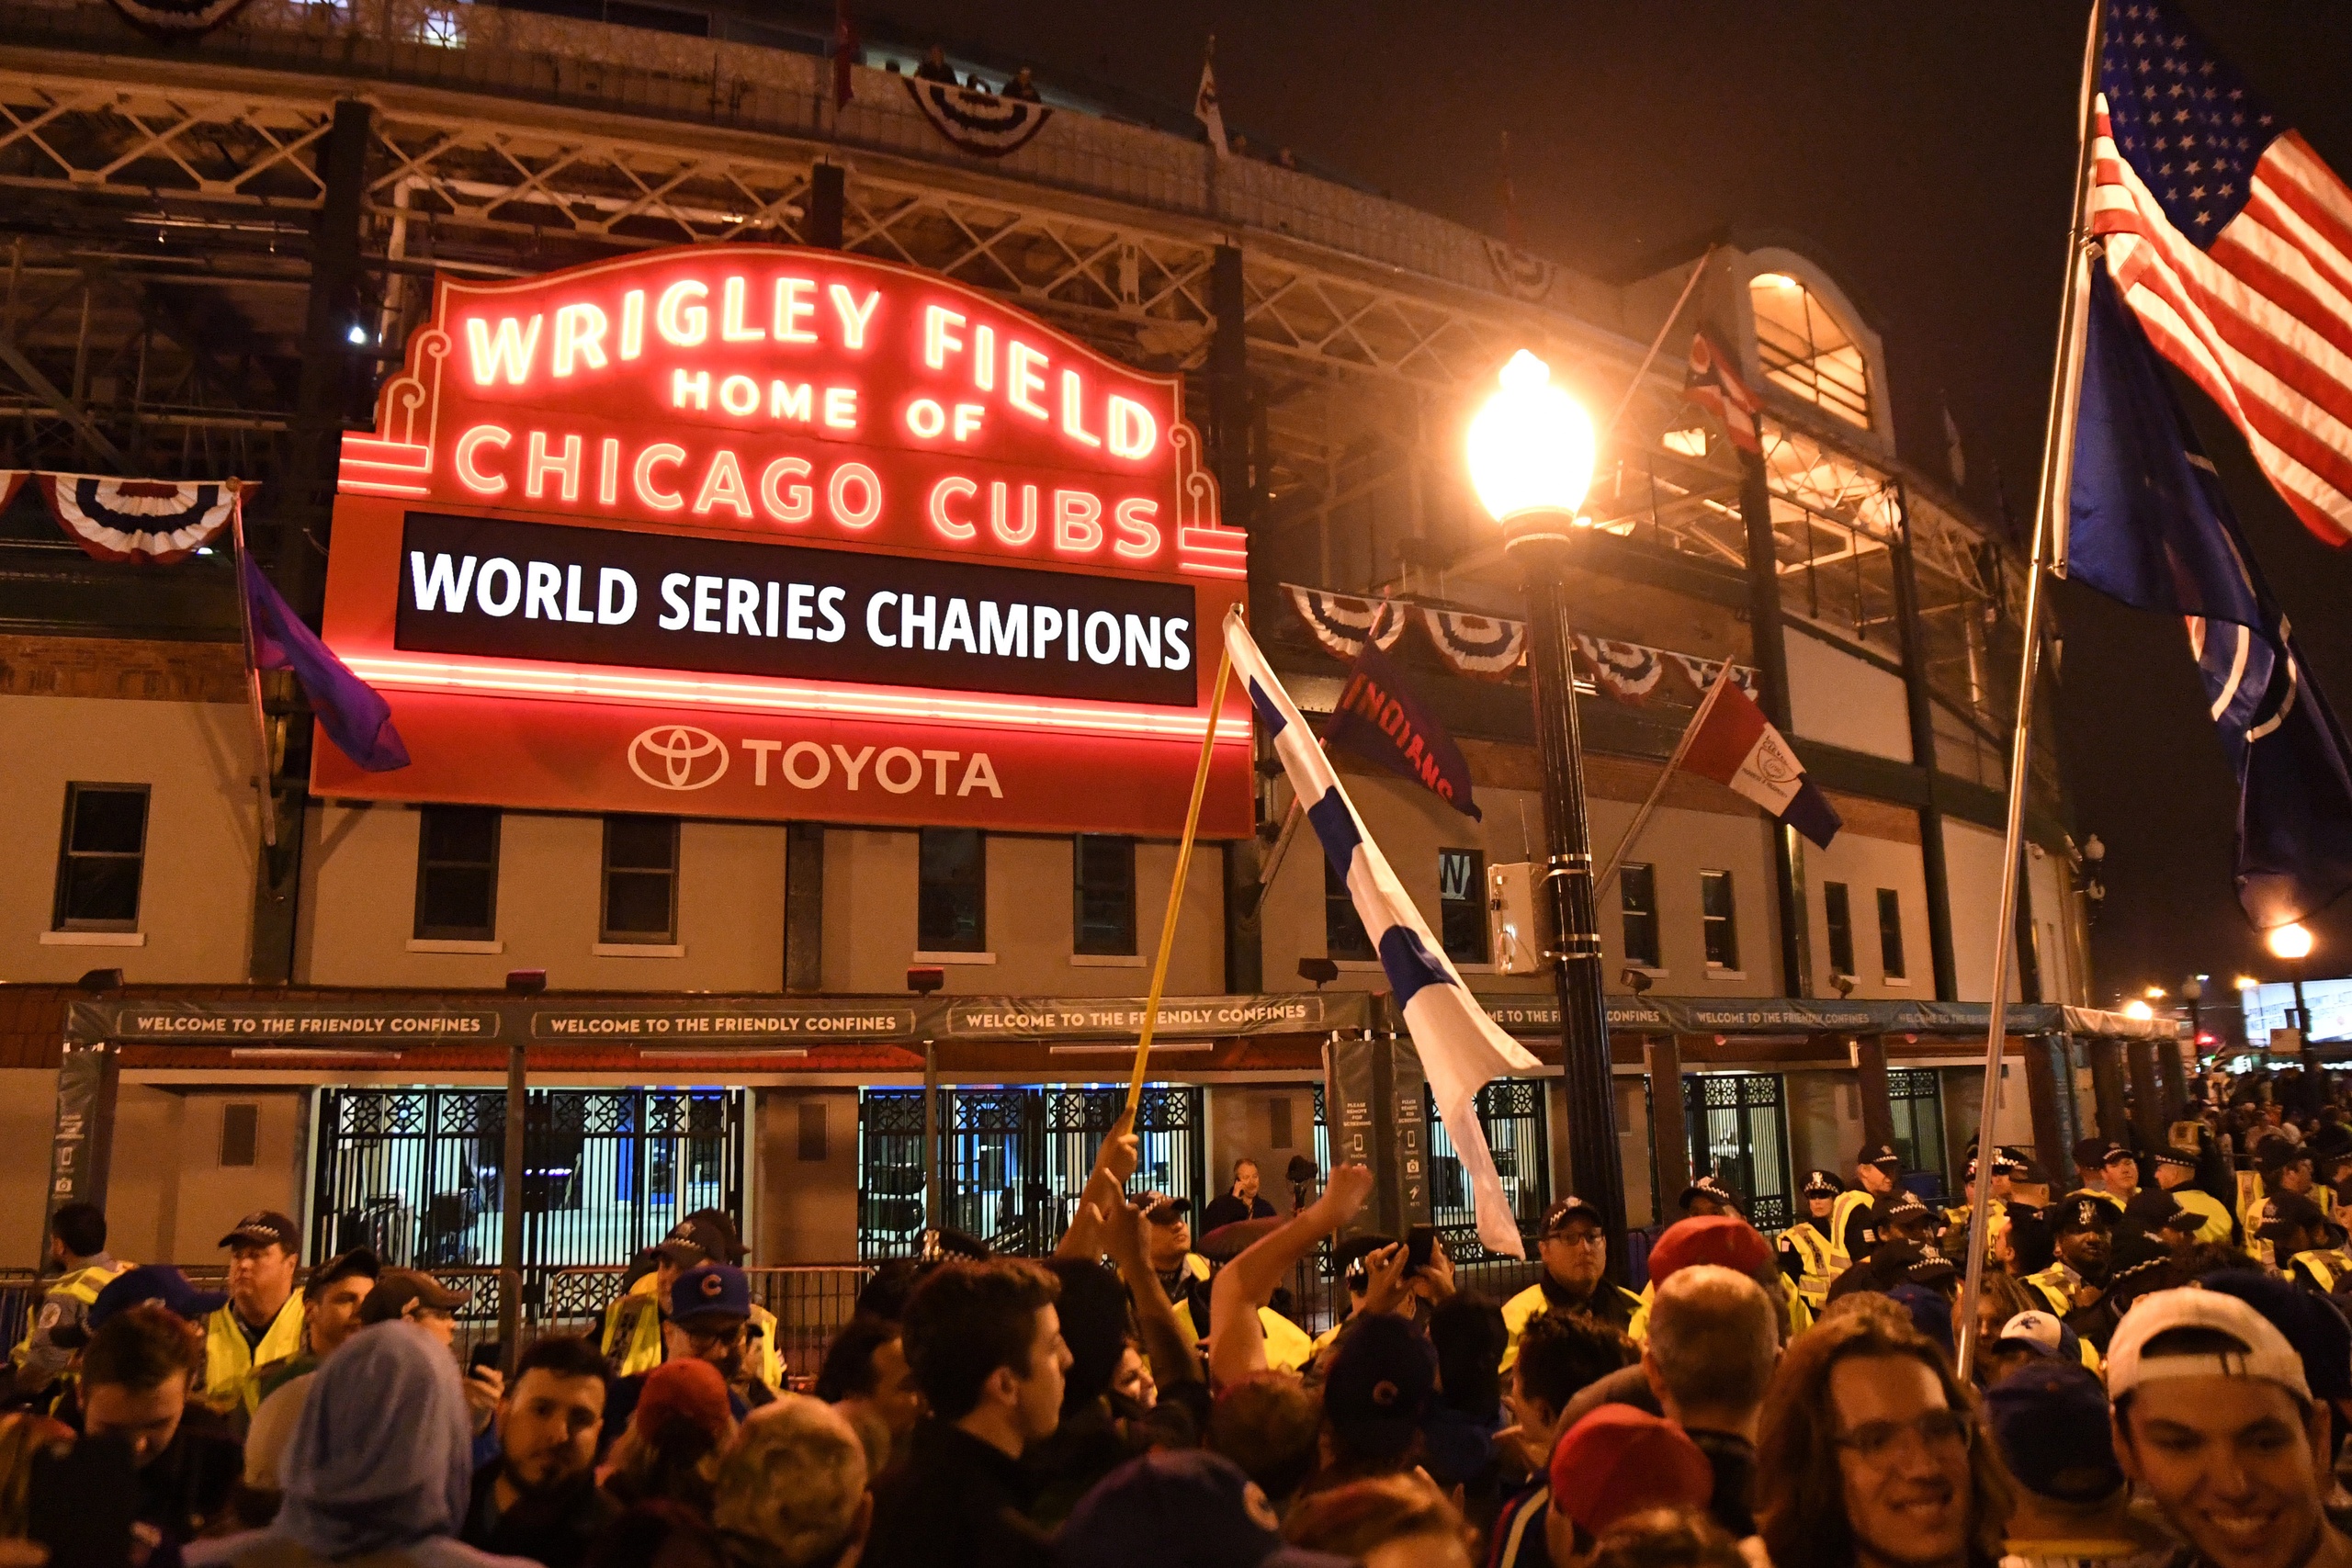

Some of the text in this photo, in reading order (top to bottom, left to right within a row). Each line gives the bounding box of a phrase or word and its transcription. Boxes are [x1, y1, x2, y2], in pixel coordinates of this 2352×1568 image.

[465, 276, 1159, 459] WRIGLEY FIELD
[673, 370, 986, 442] HOME OF
[455, 425, 1162, 558] CHICAGO CUBS
[411, 550, 1191, 671] WORLD SERIES CHAMPIONS
[1341, 671, 1453, 803] INDIANS
[742, 738, 1004, 799] TOYOTA
[138, 1016, 481, 1032] WELCOME TO THE FRIENDLY CONFINES
[551, 1016, 897, 1033] WELCOME TO THE FRIENDLY CONFINES
[966, 1005, 1306, 1028] WELCOME TO THE FRENDLY CONFINES
[1507, 1010, 1523, 1022] TO
[1526, 1010, 1549, 1022] THE
[1607, 1010, 1659, 1022] CONFINES
[1697, 1012, 1745, 1023] WELCOME
[1747, 1012, 1760, 1023] TO
[1762, 1012, 1781, 1023] THE
[1825, 1013, 1870, 1024] CONFINES
[702, 1274, 722, 1296] C
